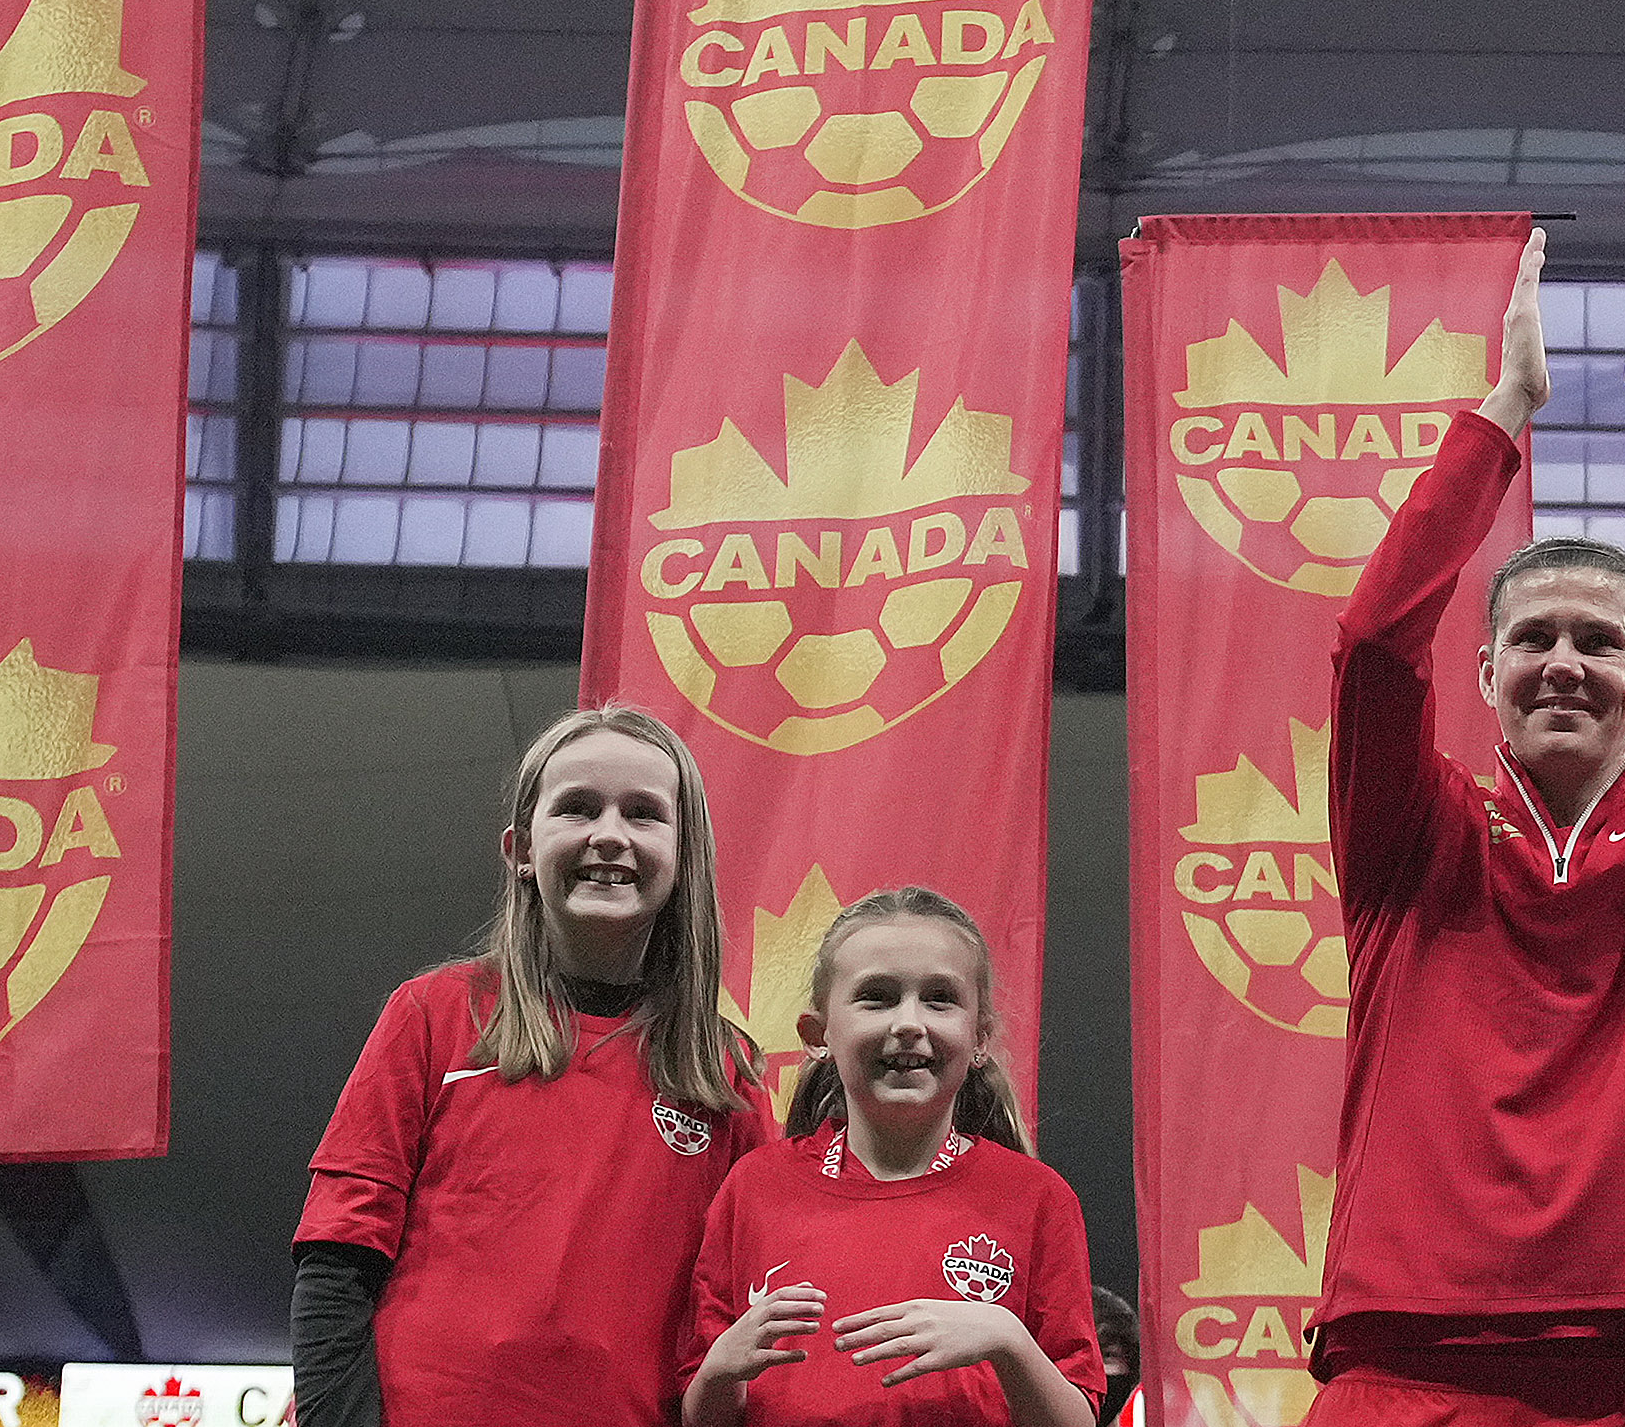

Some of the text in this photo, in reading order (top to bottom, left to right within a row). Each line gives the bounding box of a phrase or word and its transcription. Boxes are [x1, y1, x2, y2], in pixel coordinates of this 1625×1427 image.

[1170, 411, 1454, 465] CANAD
[640, 507, 1029, 599] CANADA
[1174, 851, 1341, 903] CAN
[654, 1107, 707, 1133] CANAD
[944, 1258, 1011, 1284] CANADA
